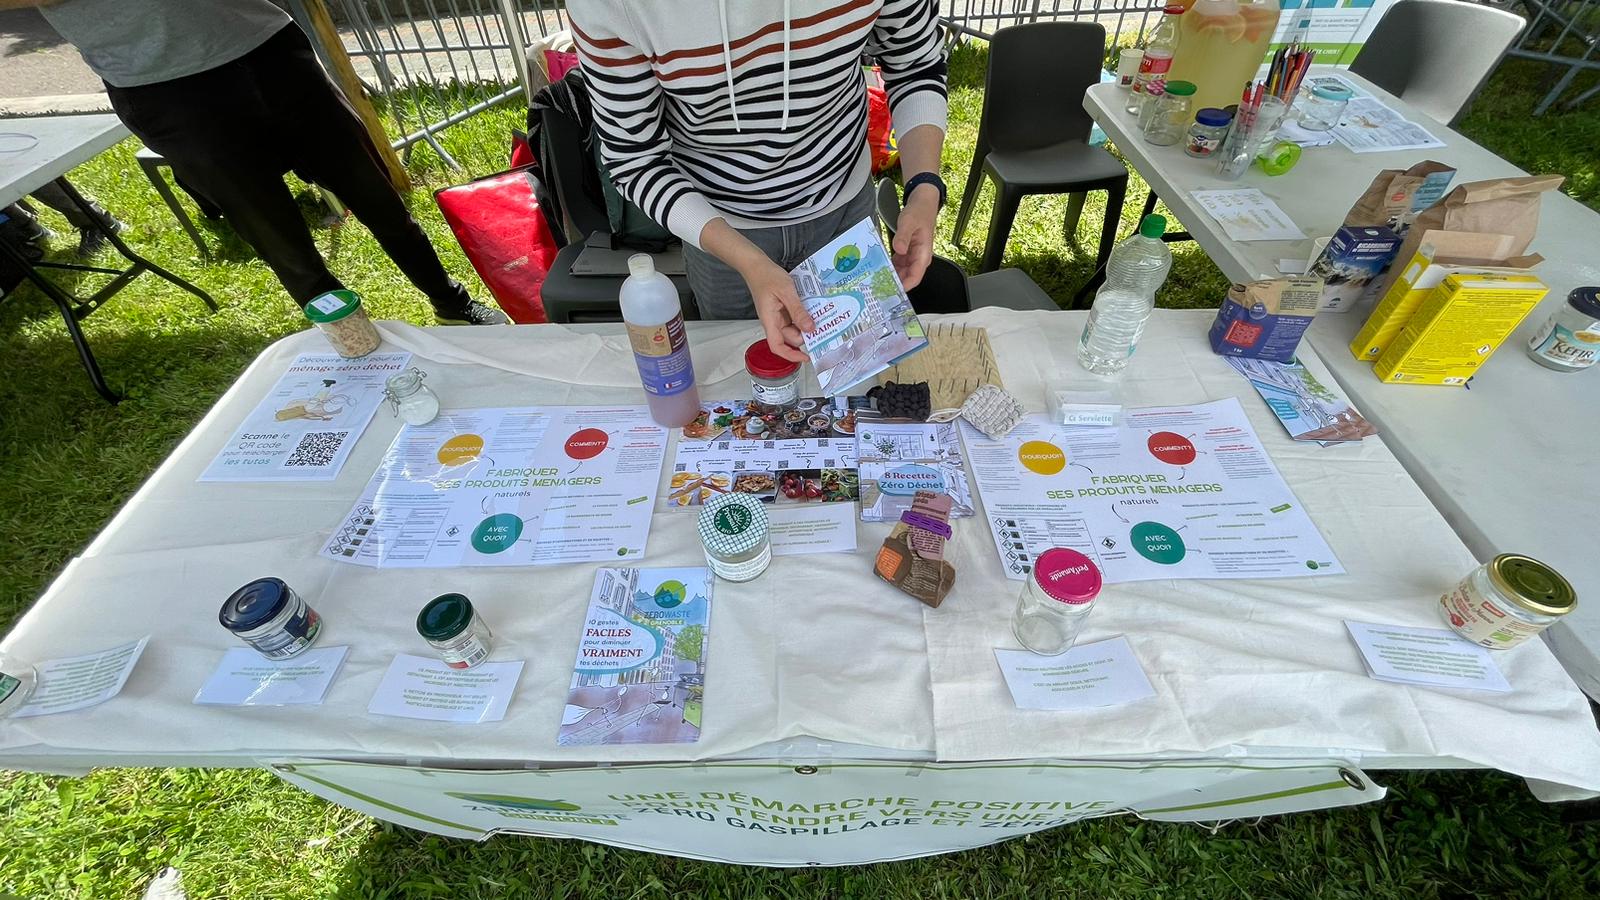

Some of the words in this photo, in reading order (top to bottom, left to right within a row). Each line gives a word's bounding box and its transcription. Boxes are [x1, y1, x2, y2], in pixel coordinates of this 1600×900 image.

[810, 302, 835, 320] CILES
[806, 310, 851, 340] VRAIMENT
[289, 365, 334, 373] ménage
[362, 362, 401, 371] déchet
[1079, 414, 1112, 422] Serviette
[238, 442, 256, 450] QR
[256, 441, 282, 449] code
[486, 467, 558, 477] FABRIQUER
[465, 478, 529, 488] PRODUITS
[532, 476, 603, 487] MENAGERS
[1091, 474, 1168, 484] FABRIQUER
[880, 481, 905, 489] Zéro
[907, 481, 944, 489] Déchet
[494, 490, 532, 498] naturels
[1046, 489, 1075, 499] SES
[1078, 485, 1147, 498] PRODUITS
[1149, 483, 1223, 494] MENAGERS
[1120, 498, 1159, 506] naturels
[721, 506, 740, 534] Prosain
[586, 628, 632, 637] FACILES
[582, 648, 644, 657] VRAIMENT
[607, 791, 690, 801] UNE
[700, 791, 919, 814] DÉMARCHE
[929, 800, 1115, 811] POSITIVE
[621, 801, 720, 812] POUR
[726, 804, 868, 826] TENDRE
[879, 808, 972, 818] VERS
[981, 813, 1053, 821] UNE
[726, 817, 923, 836] GASPILLAGE
[932, 819, 973, 827] ET
